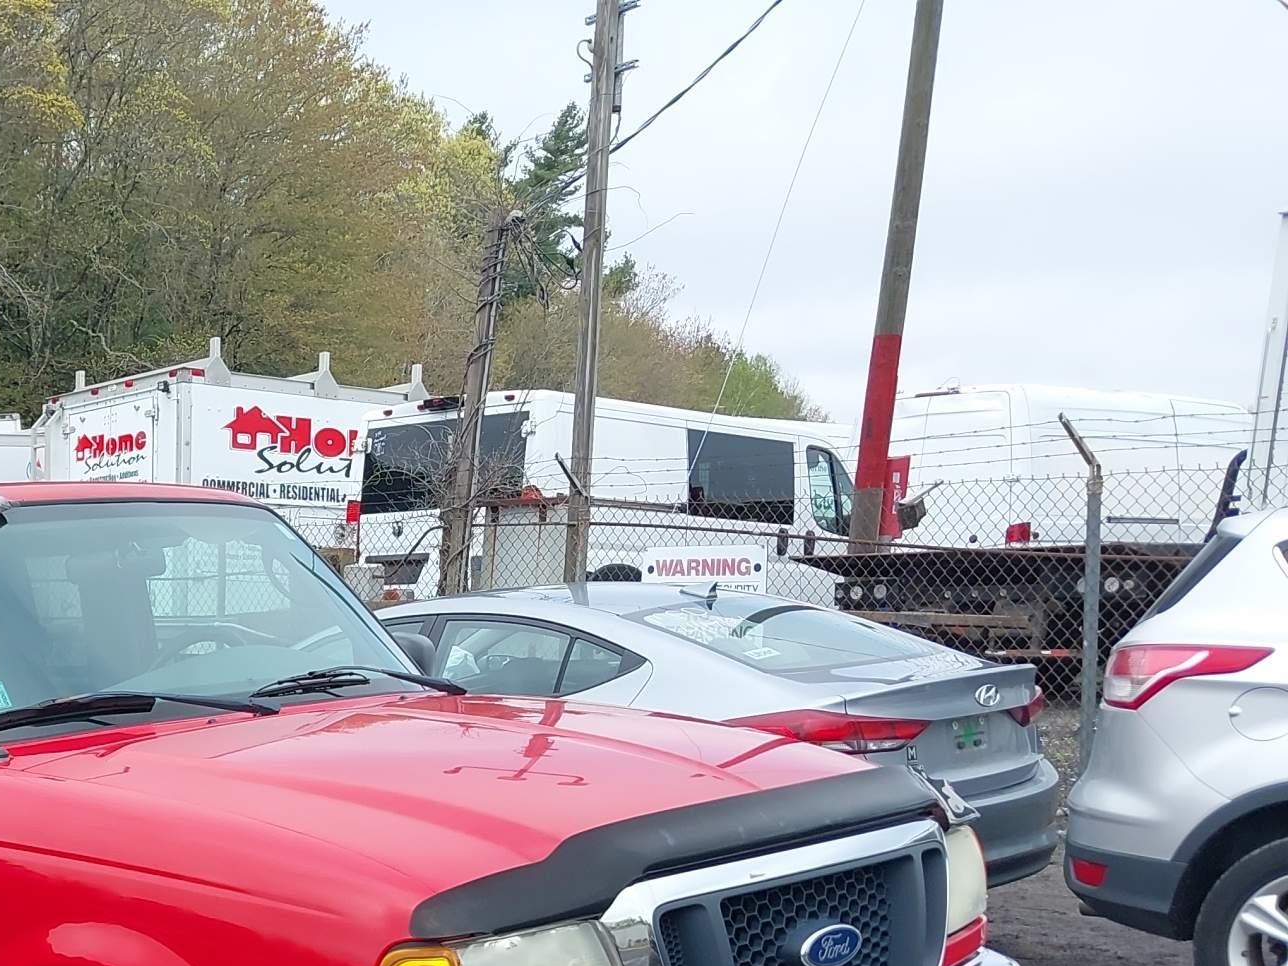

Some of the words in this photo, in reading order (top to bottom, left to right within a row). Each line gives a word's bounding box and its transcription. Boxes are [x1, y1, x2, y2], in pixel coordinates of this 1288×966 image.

[92, 431, 147, 458] Home
[275, 415, 358, 457] Ho
[84, 452, 147, 475] Solution
[279, 483, 340, 503] RESIDENTIAL
[655, 557, 752, 577] WARNING
[818, 933, 850, 962] Ford
